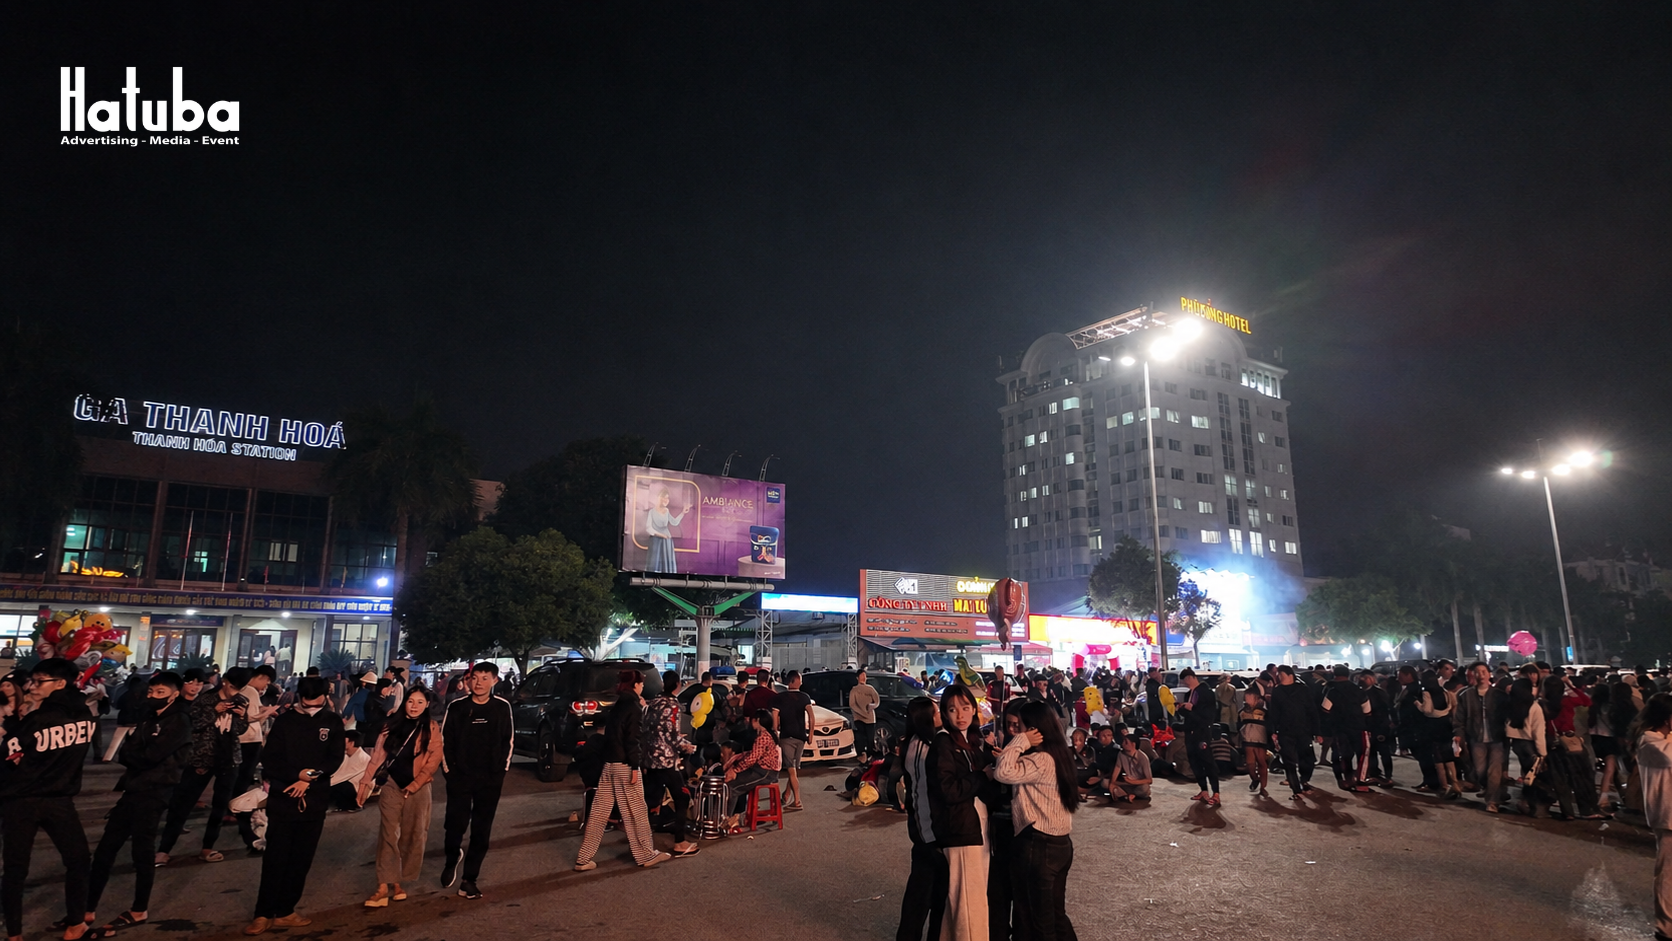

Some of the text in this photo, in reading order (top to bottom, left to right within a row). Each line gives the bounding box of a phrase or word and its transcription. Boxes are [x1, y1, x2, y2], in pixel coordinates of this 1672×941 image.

[1223, 311, 1252, 335] HOTEL
[74, 393, 347, 451] GA THANH HOÁ
[132, 430, 297, 462] THANH HÓA STATION
[702, 496, 754, 509] AMBIANCE
[953, 599, 973, 612] MAI
